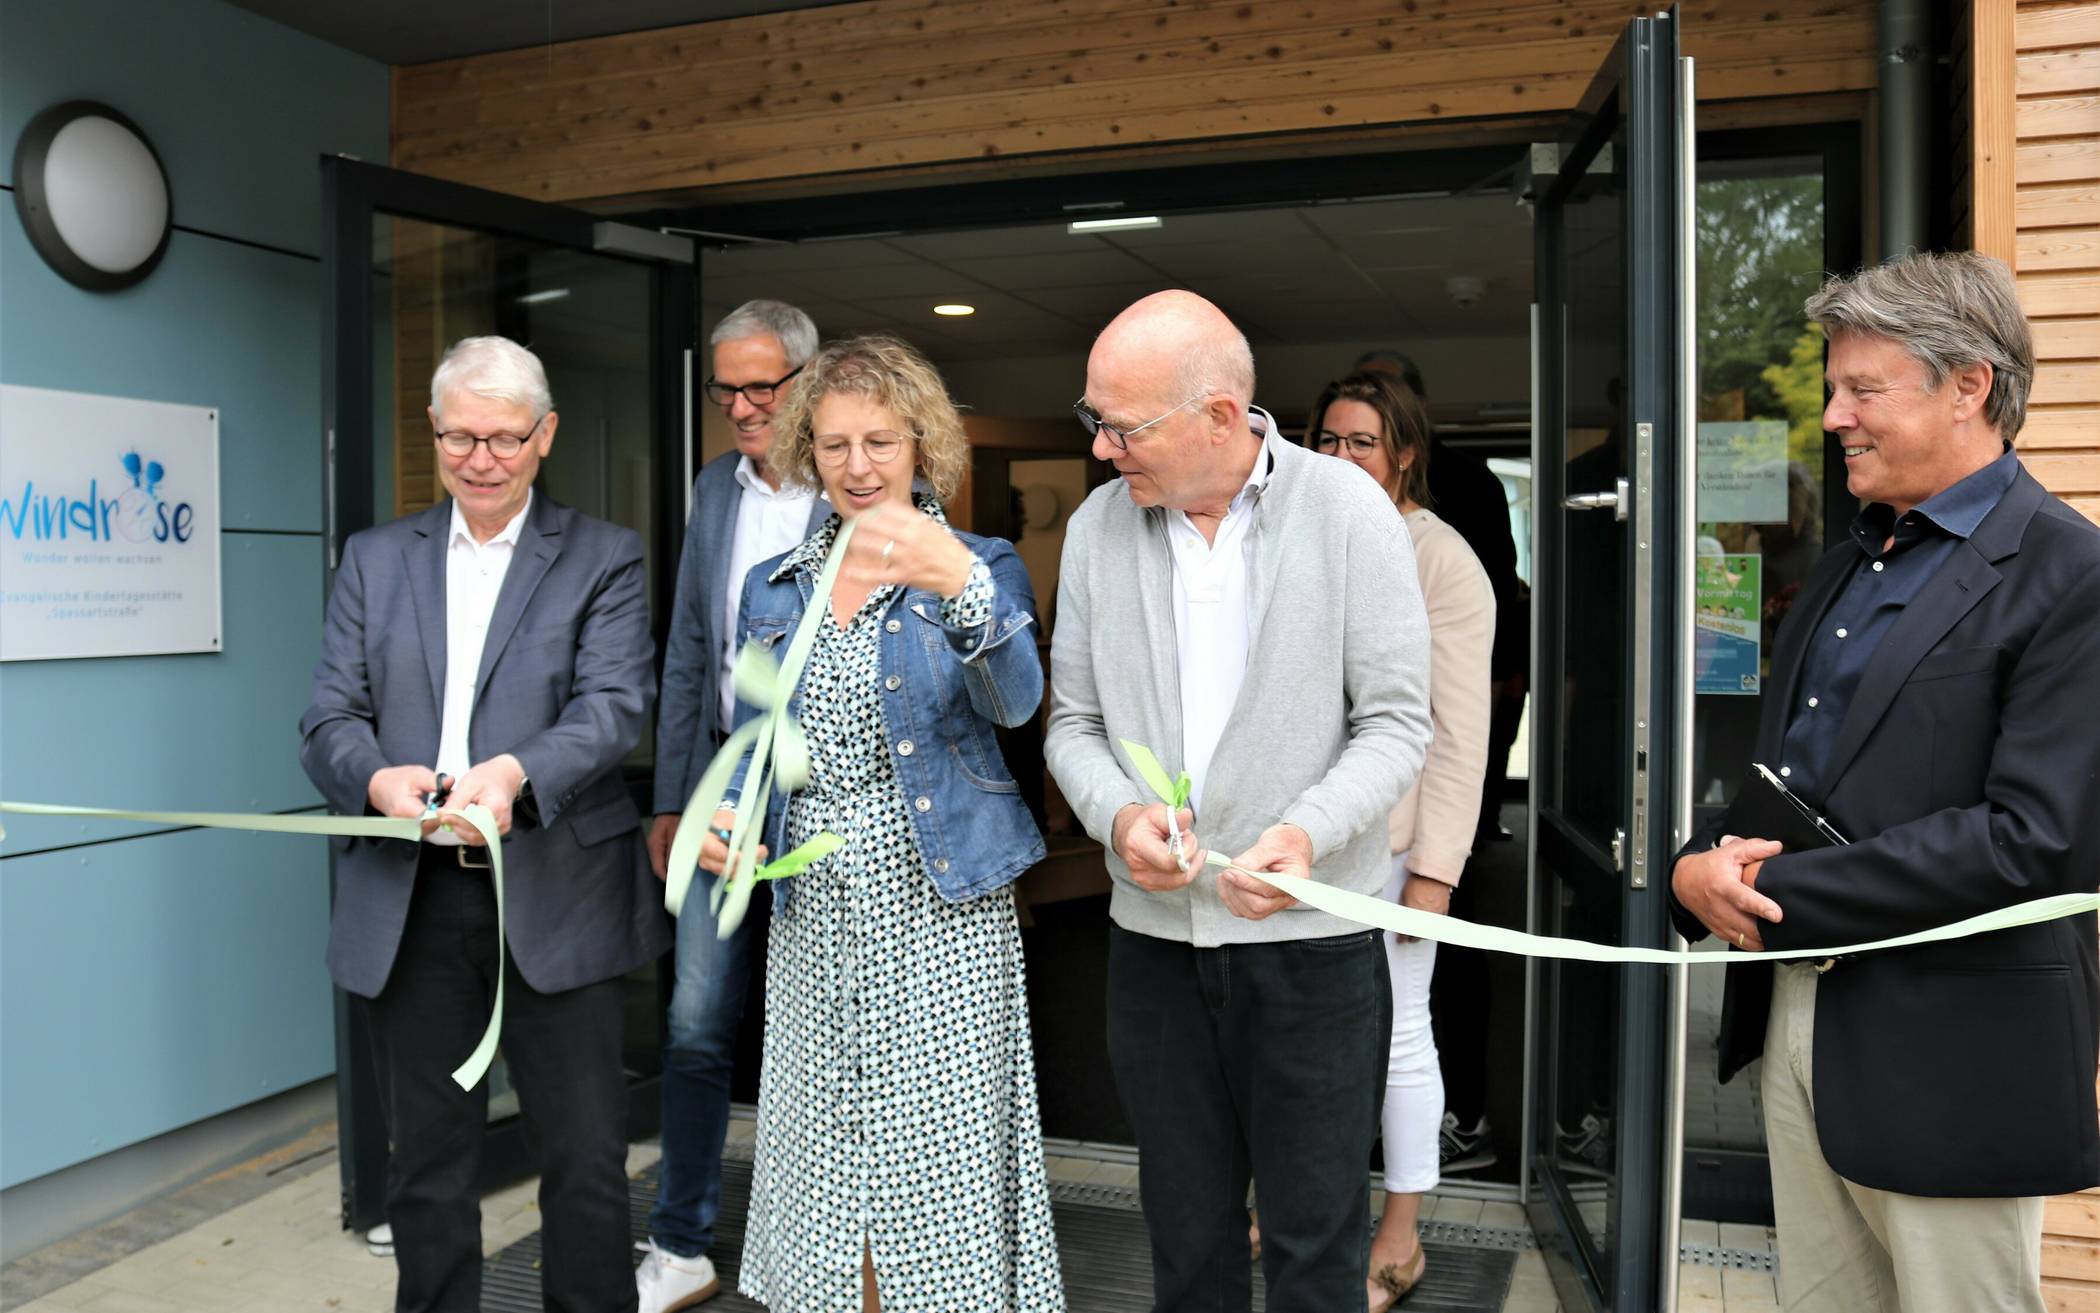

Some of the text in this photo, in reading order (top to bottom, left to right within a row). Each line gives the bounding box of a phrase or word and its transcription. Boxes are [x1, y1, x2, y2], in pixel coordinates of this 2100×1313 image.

[23, 552, 163, 565] Wunder wollen wachsen
[83, 589, 183, 603] Kindertagesstätte
